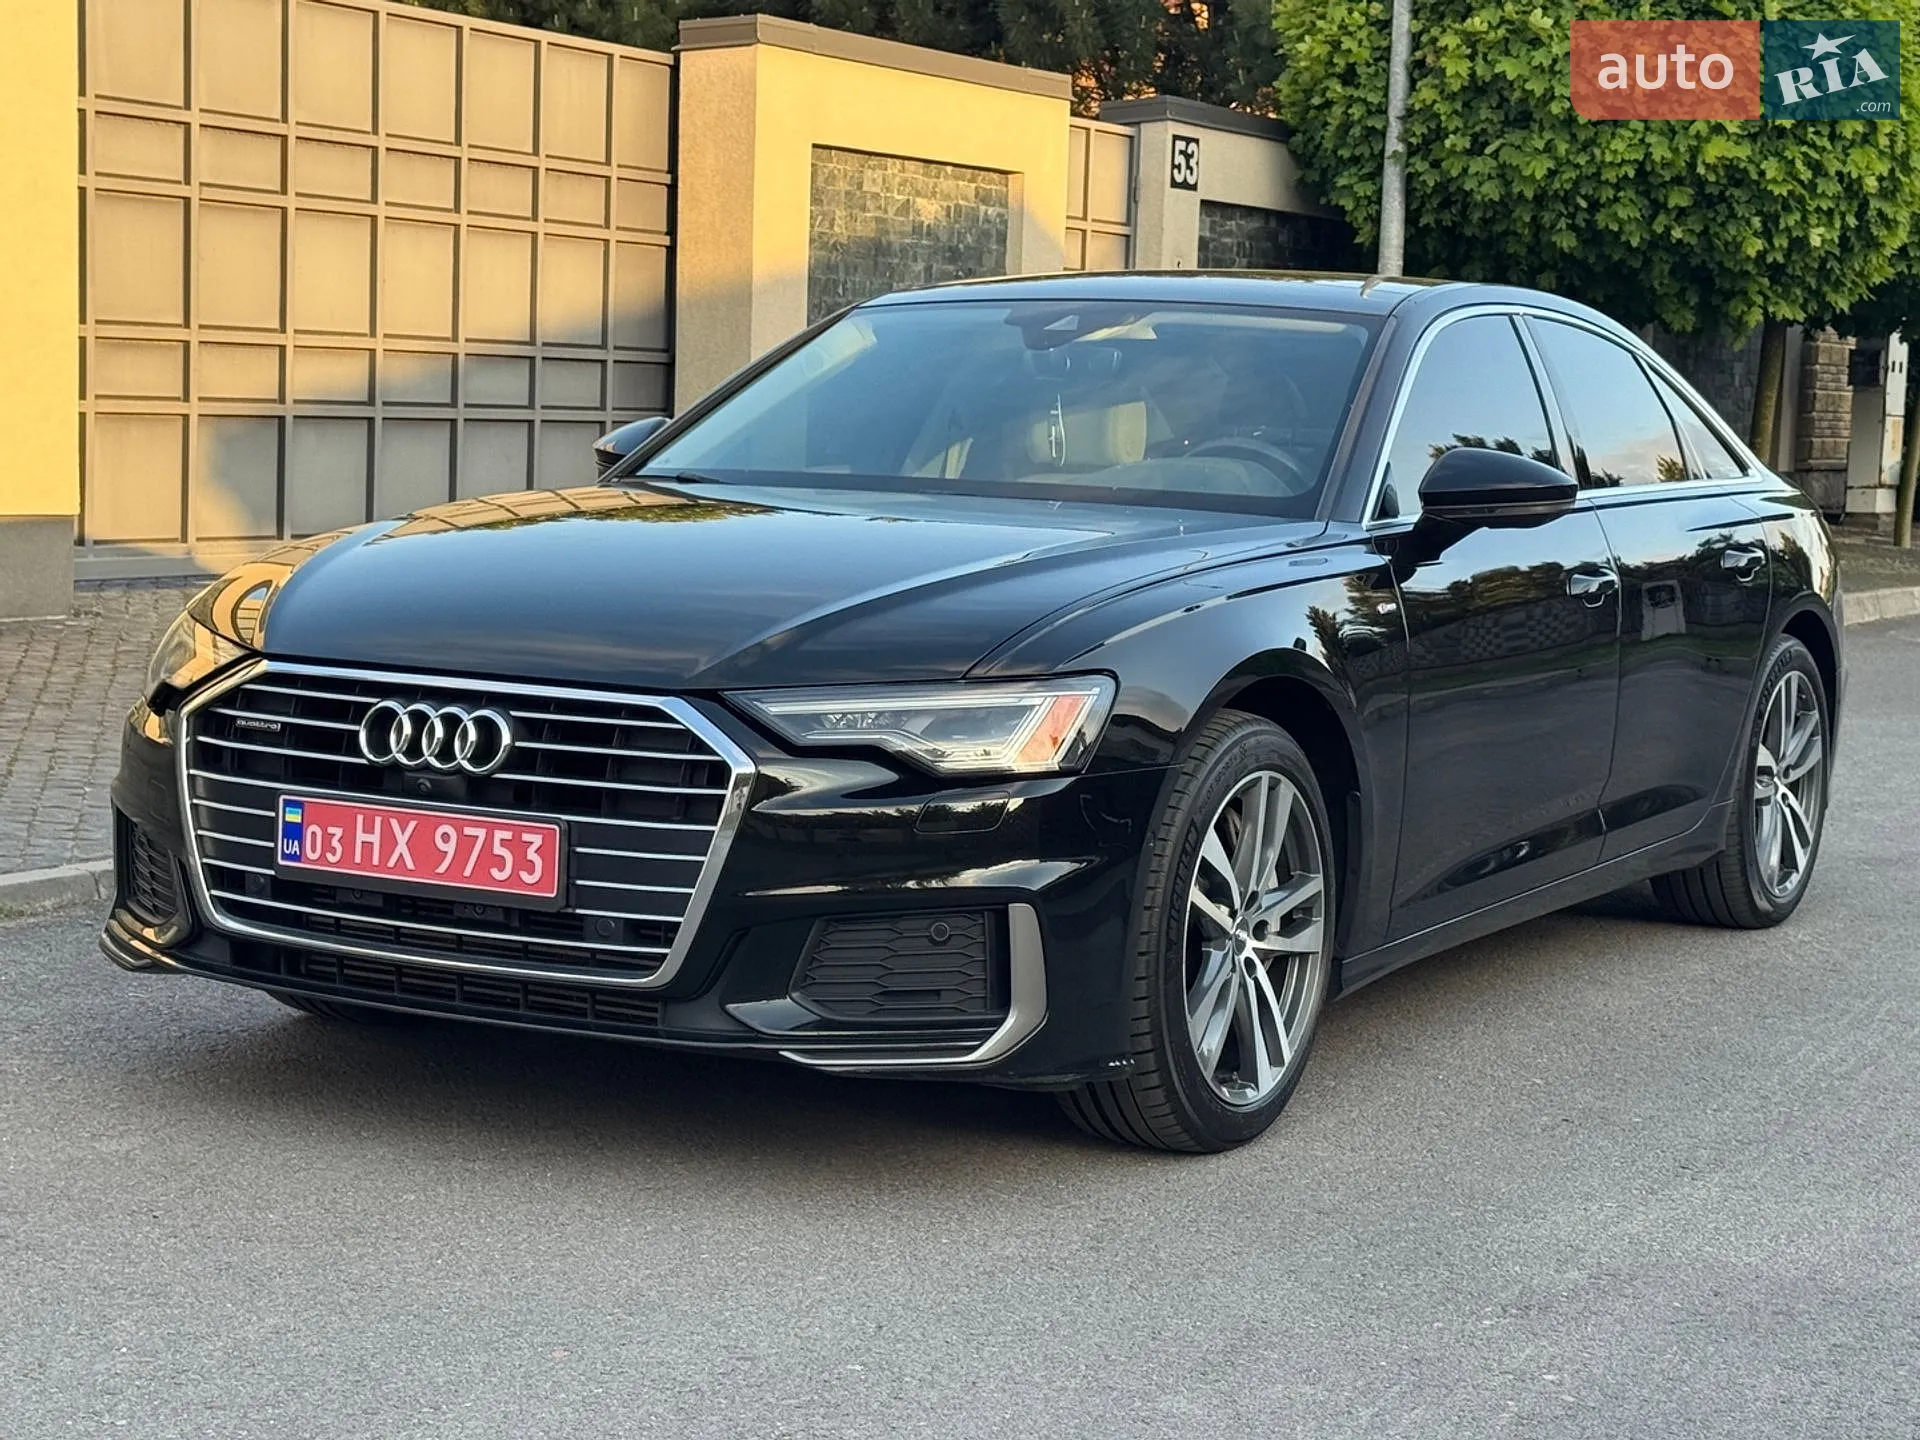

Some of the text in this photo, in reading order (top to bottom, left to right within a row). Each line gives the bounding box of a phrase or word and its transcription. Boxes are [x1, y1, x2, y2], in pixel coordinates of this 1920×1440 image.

[1173, 140, 1199, 185] 53
[283, 838, 300, 855] UA
[305, 814, 544, 885] 03 HX 9753
